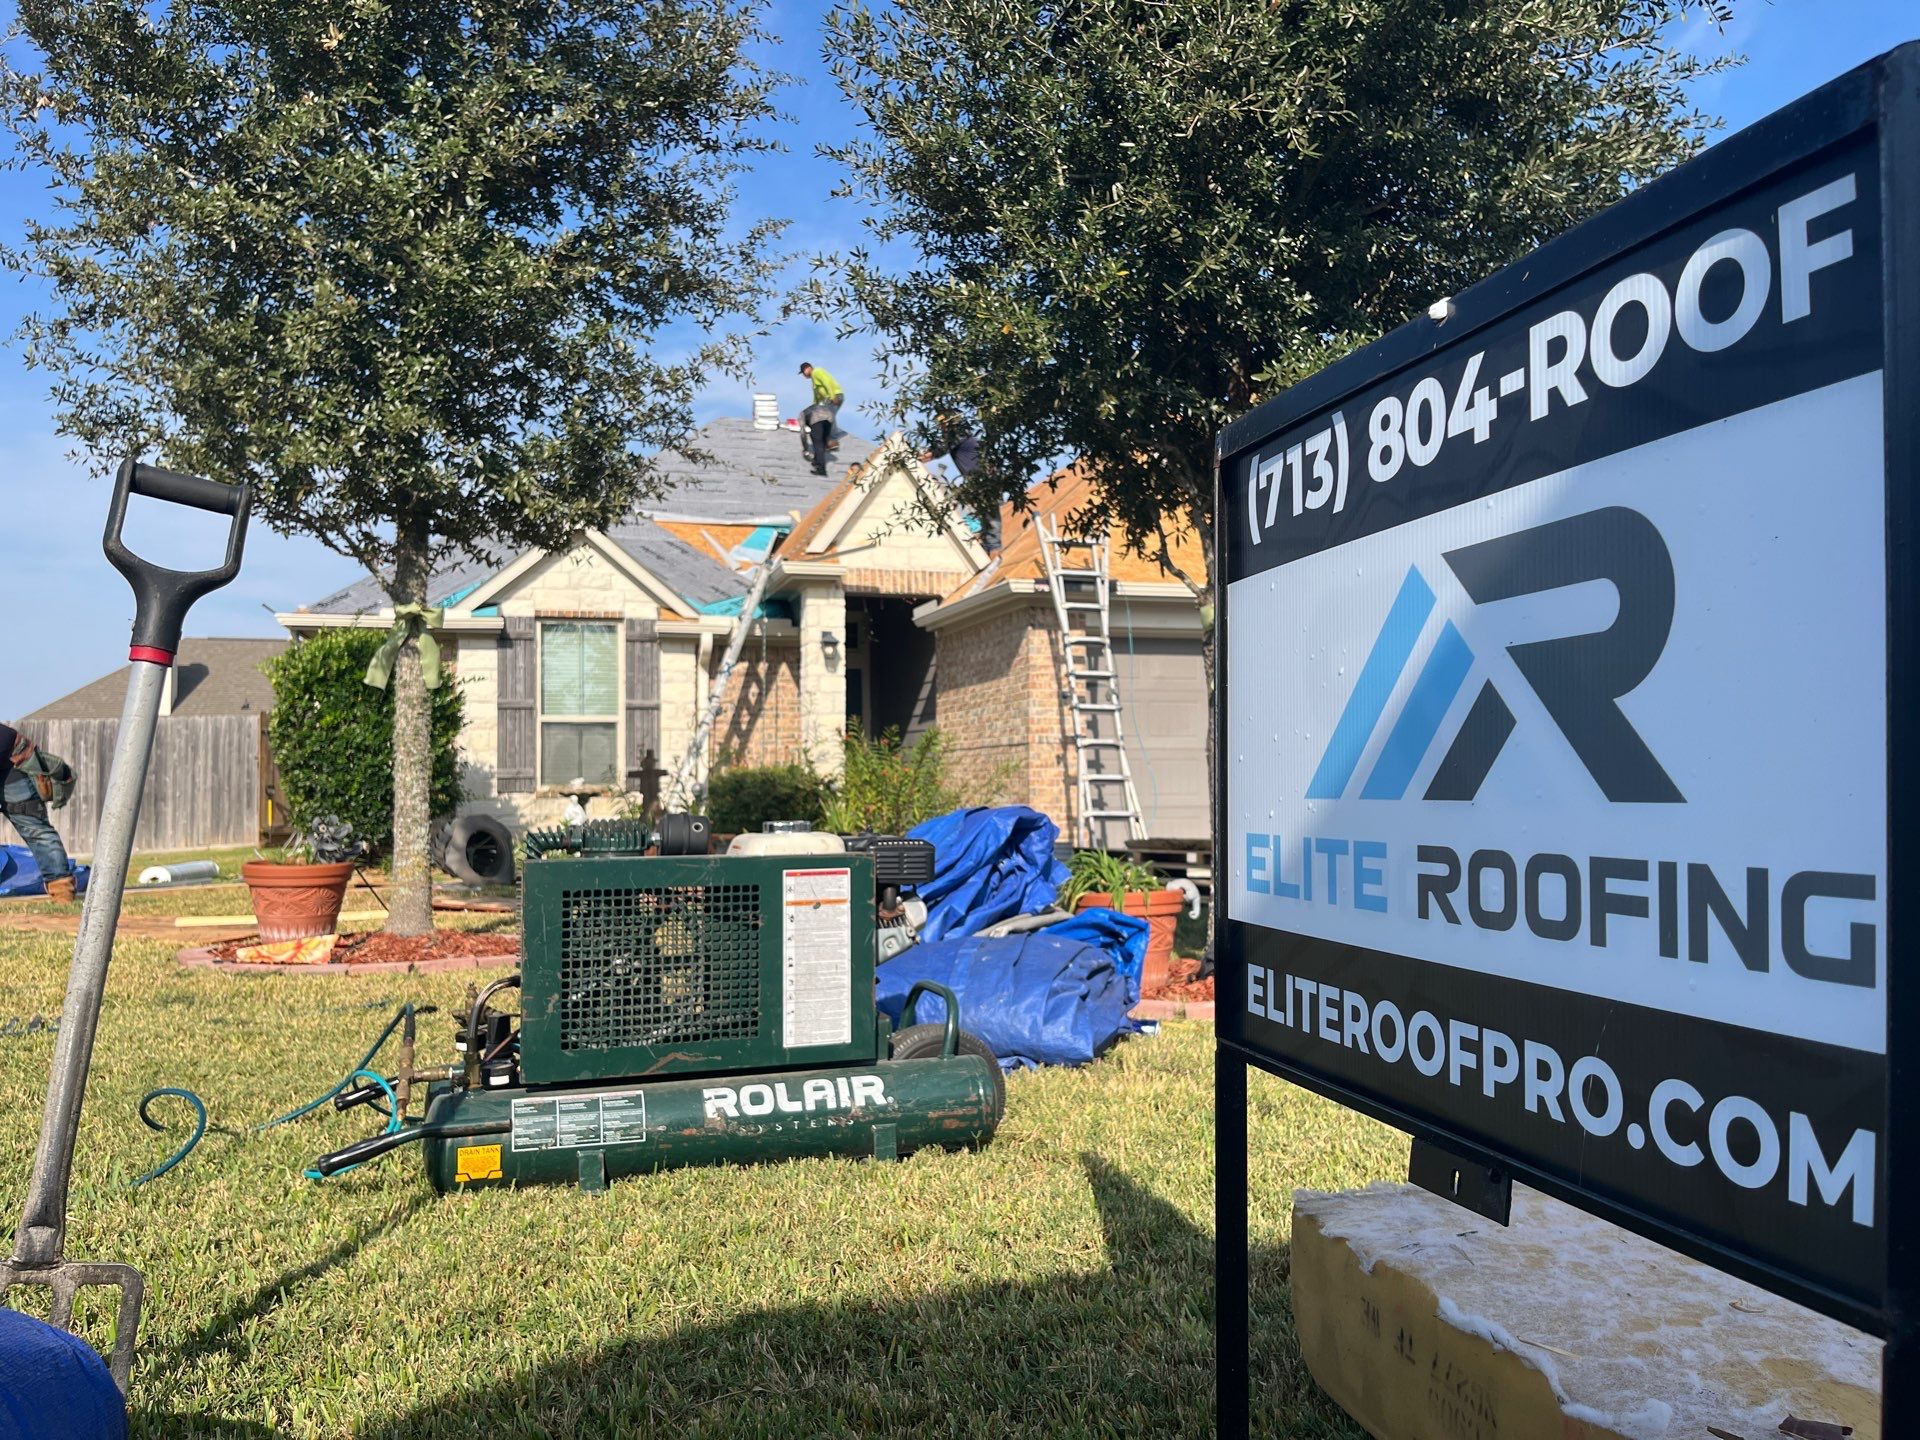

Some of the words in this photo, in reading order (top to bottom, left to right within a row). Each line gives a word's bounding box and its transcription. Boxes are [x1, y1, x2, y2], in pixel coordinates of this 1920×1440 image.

[1248, 411, 1349, 544] (713)
[1368, 173, 1857, 483] 804-ROOF
[1246, 833, 1387, 913] ELITE
[1417, 845, 1876, 990] ROOFING
[703, 1075, 888, 1118] ROLAIR
[739, 1116, 854, 1134] STEM
[1247, 965, 1876, 1228] ELITEROOFPRO.COM
[460, 1148, 480, 1156] DRAIN
